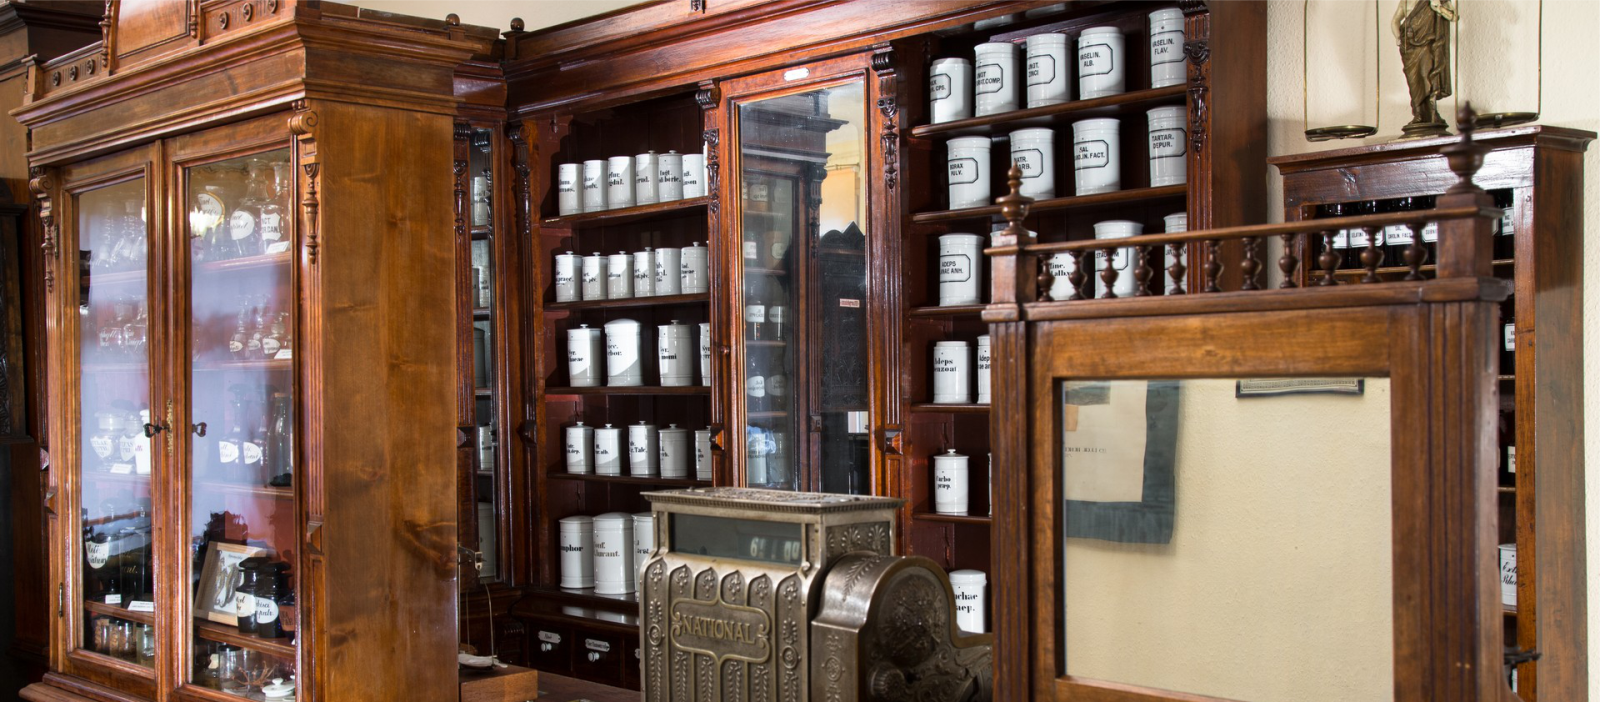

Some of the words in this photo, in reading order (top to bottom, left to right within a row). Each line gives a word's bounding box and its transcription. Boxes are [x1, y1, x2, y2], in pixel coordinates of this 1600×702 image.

[1154, 47, 1169, 55] FLAV.
[1083, 60, 1095, 68] ALB.
[1153, 141, 1173, 149] DEPUR.
[681, 614, 757, 646] NATIONAL
